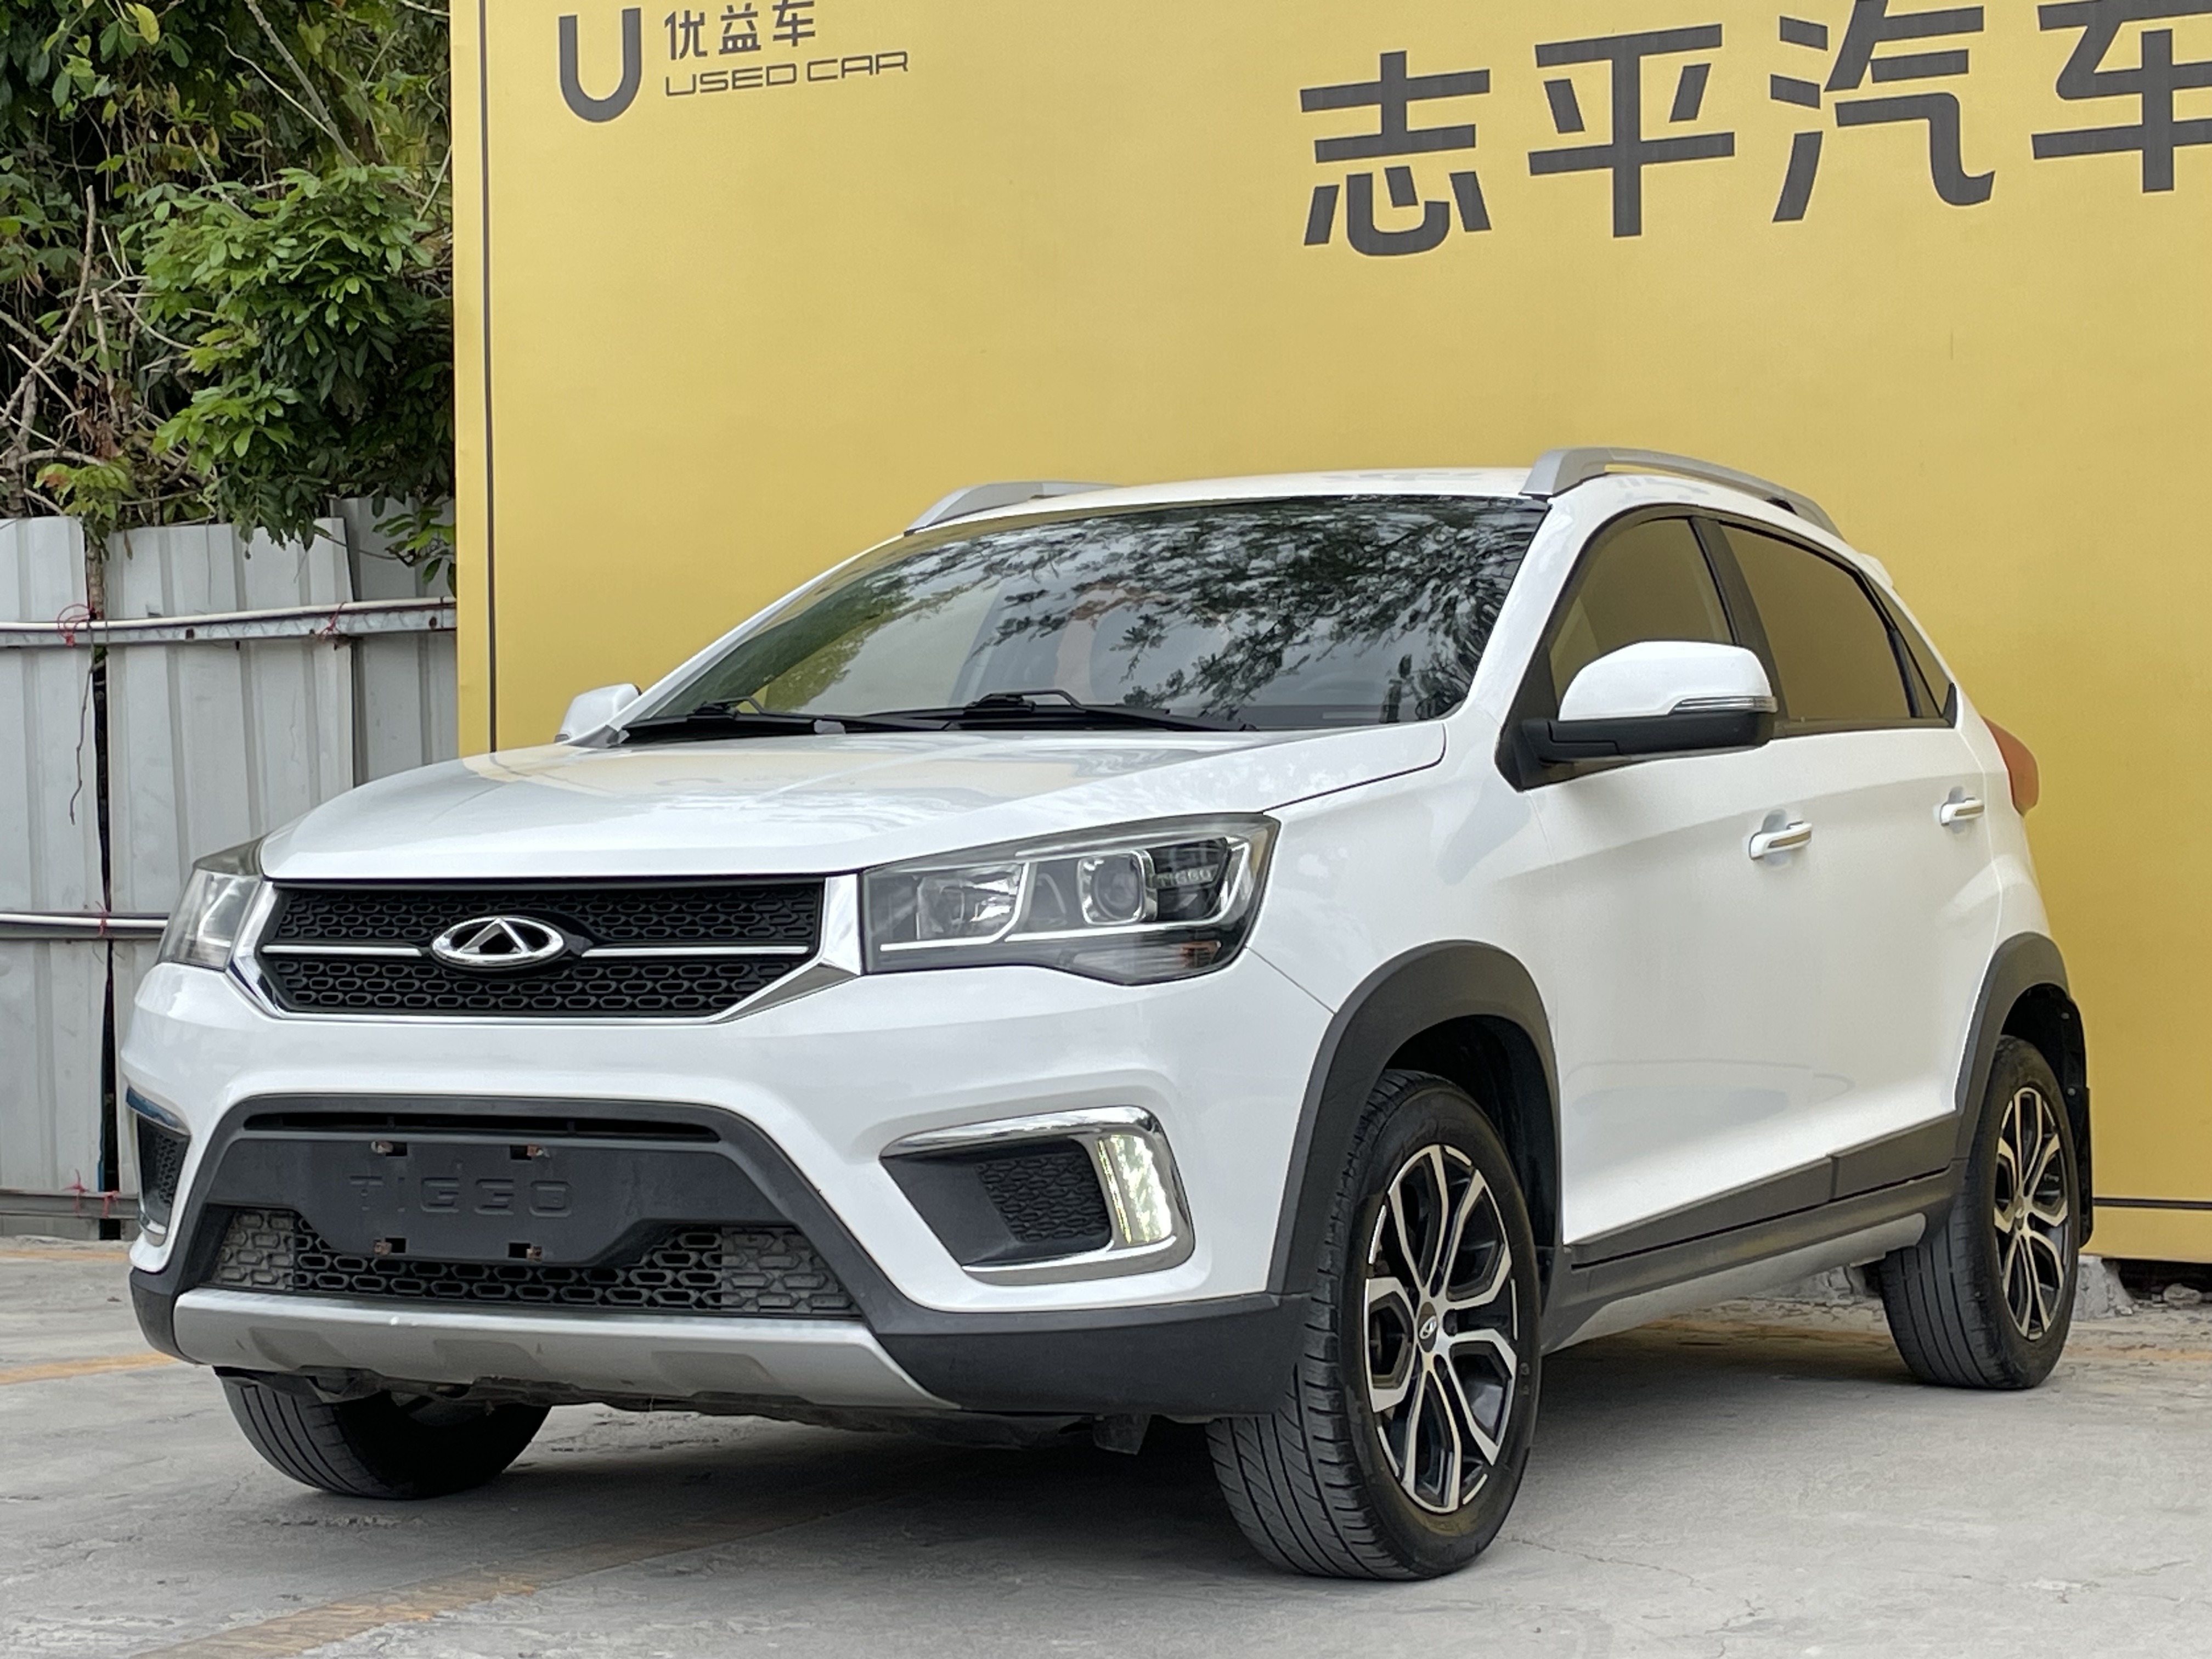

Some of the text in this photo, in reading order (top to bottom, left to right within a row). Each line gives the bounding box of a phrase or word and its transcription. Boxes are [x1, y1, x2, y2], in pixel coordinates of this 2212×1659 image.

[664, 0, 816, 60] 优益车
[665, 51, 909, 97] USED CAR
[1300, 0, 2212, 257] 志平汽车
[349, 1175, 572, 1218] TIGGO
